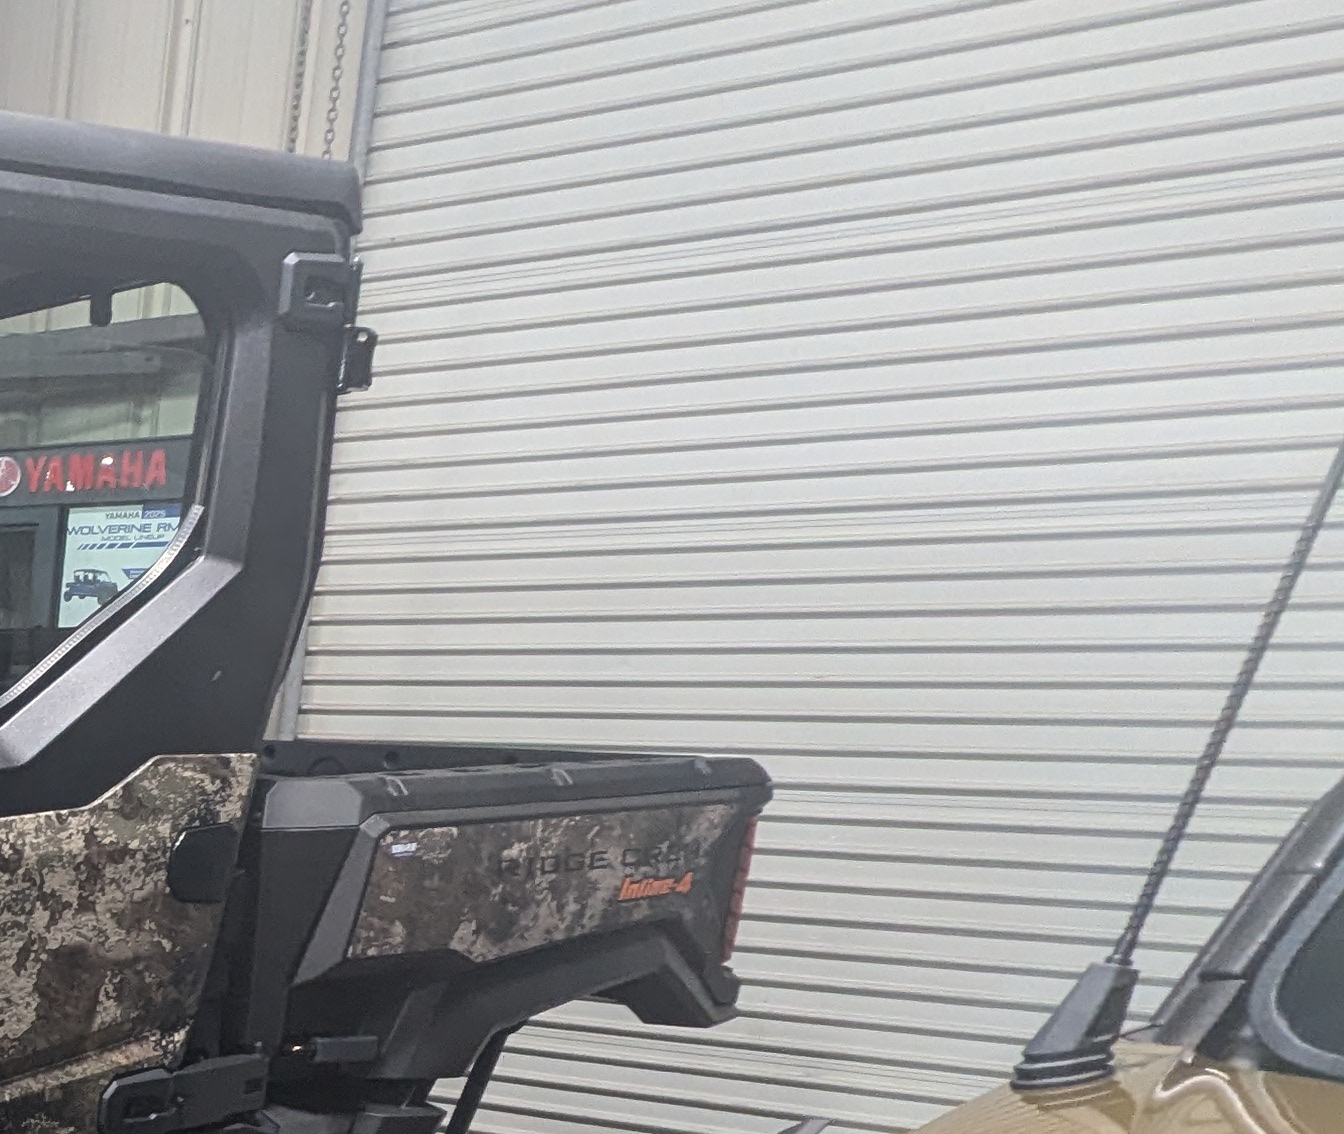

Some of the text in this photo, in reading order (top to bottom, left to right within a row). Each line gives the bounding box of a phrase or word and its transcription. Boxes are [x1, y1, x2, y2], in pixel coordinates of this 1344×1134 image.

[25, 449, 168, 493] YAMAHA
[105, 511, 140, 519] YAMAHA
[67, 522, 180, 536] WOLVERINE RM
